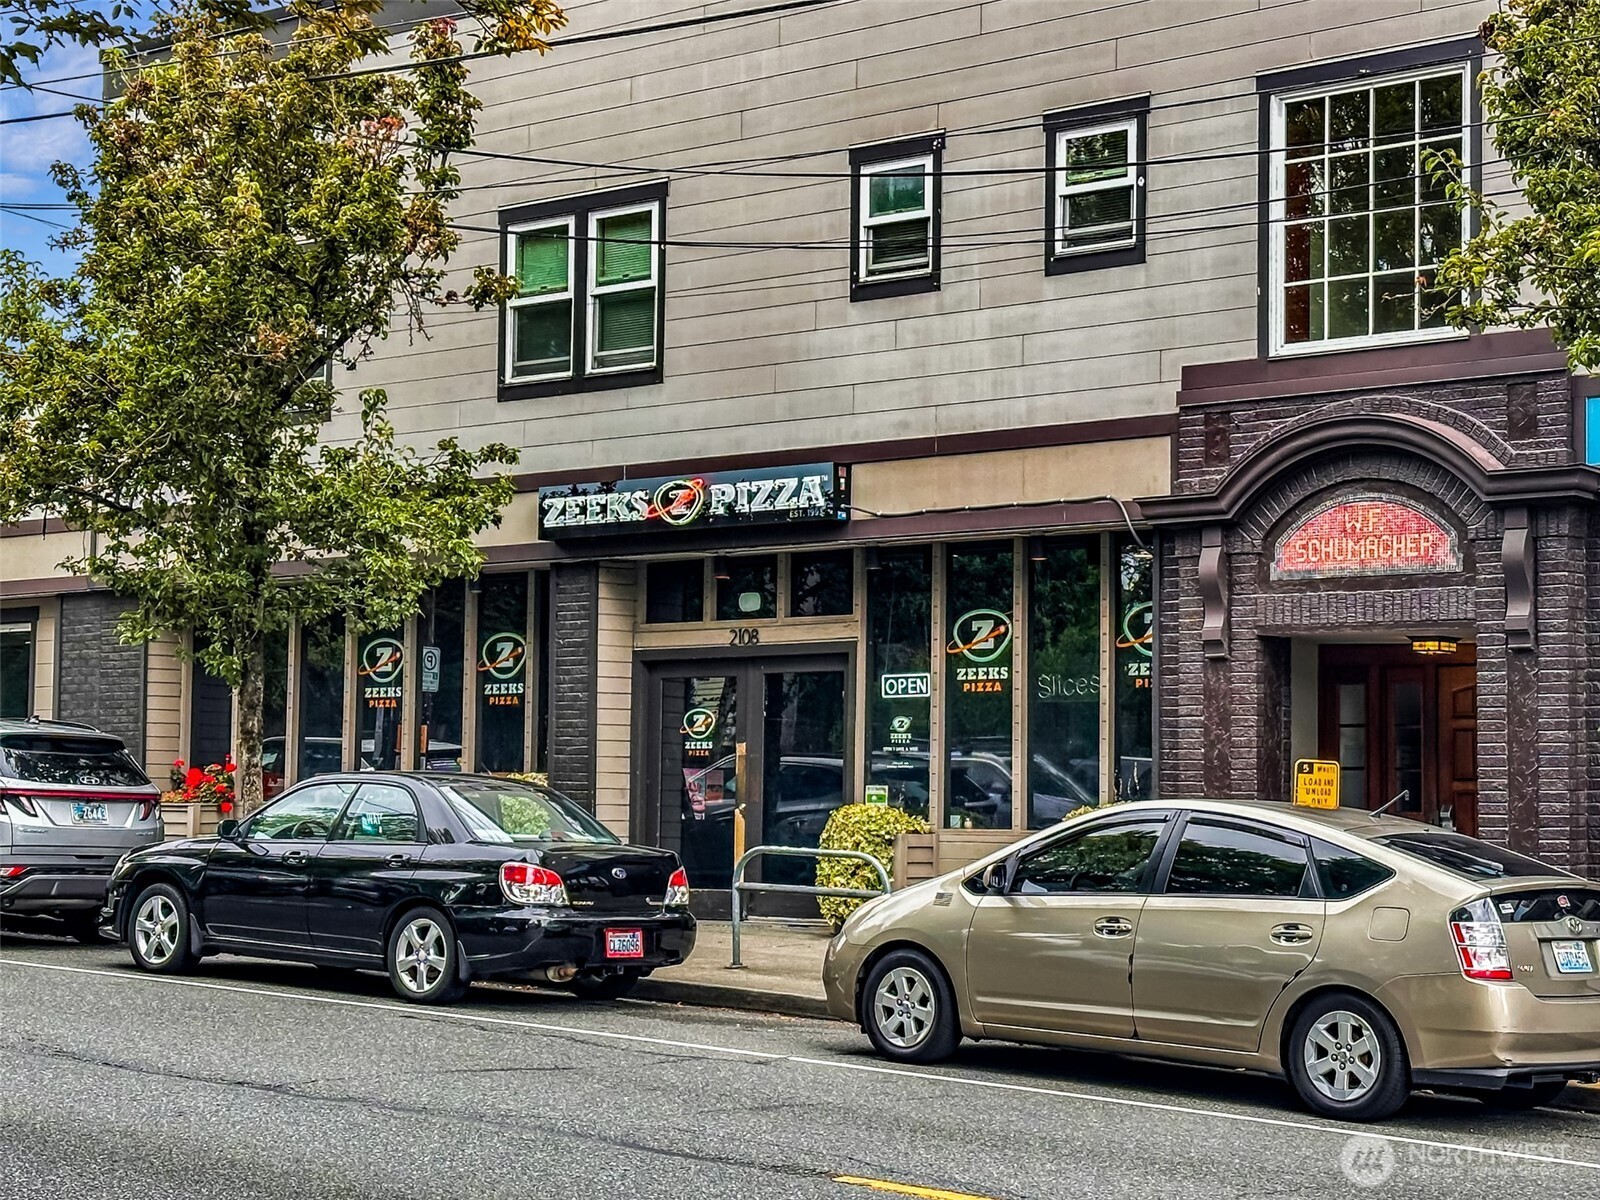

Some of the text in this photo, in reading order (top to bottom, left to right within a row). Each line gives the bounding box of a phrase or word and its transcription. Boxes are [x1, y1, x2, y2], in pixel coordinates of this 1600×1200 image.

[542, 490, 650, 528] ZEEKS
[709, 475, 825, 516] PIZZA
[789, 509, 806, 518] EST.
[729, 628, 760, 646] 2108
[956, 666, 1009, 681] ZEEKS
[484, 683, 525, 695] ZEEKS
[885, 677, 927, 694] OPEN
[963, 682, 1002, 692] PIZZA
[1038, 673, 1101, 698] Slices
[364, 687, 403, 699] ZEEKS
[368, 700, 398, 709] PIZZA
[489, 696, 520, 705] PIZZA
[684, 741, 713, 750] ZEEKS
[1303, 764, 1309, 773] 5
[1303, 777, 1322, 787] LOAD
[1305, 787, 1331, 796] UNLOAD
